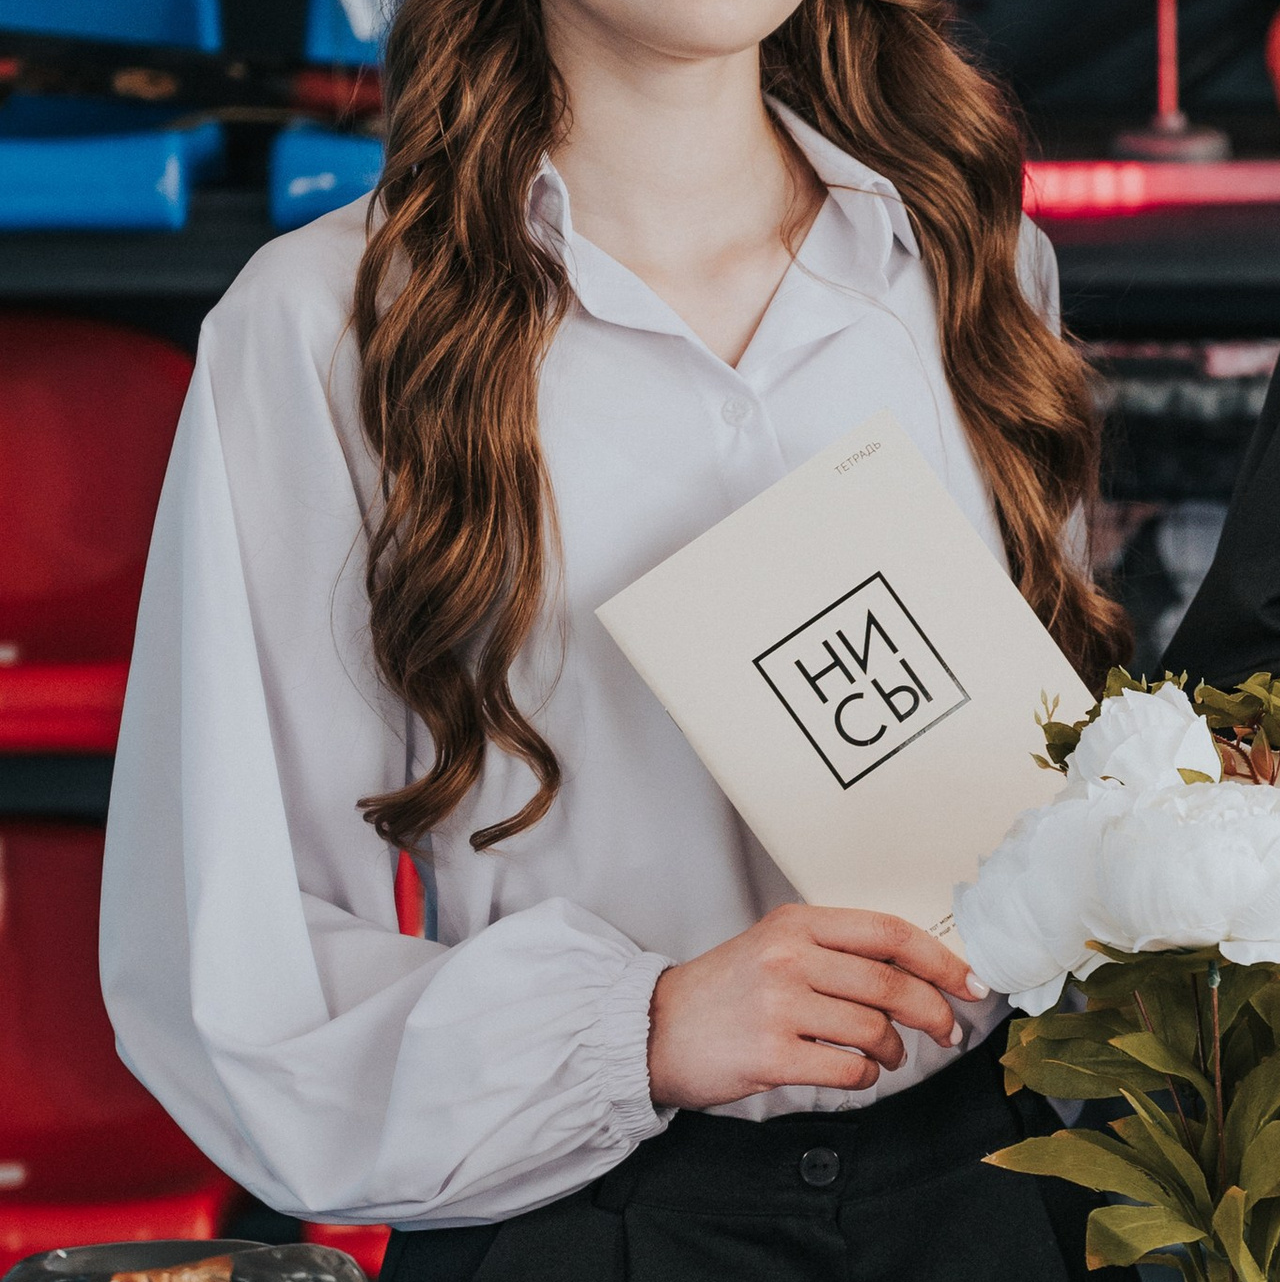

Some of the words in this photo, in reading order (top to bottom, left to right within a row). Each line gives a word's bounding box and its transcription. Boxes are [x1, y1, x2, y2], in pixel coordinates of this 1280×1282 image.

[834, 441, 882, 475] ТЕТРАДЬ
[794, 608, 899, 704] НИ
[834, 658, 933, 747] СЫ
